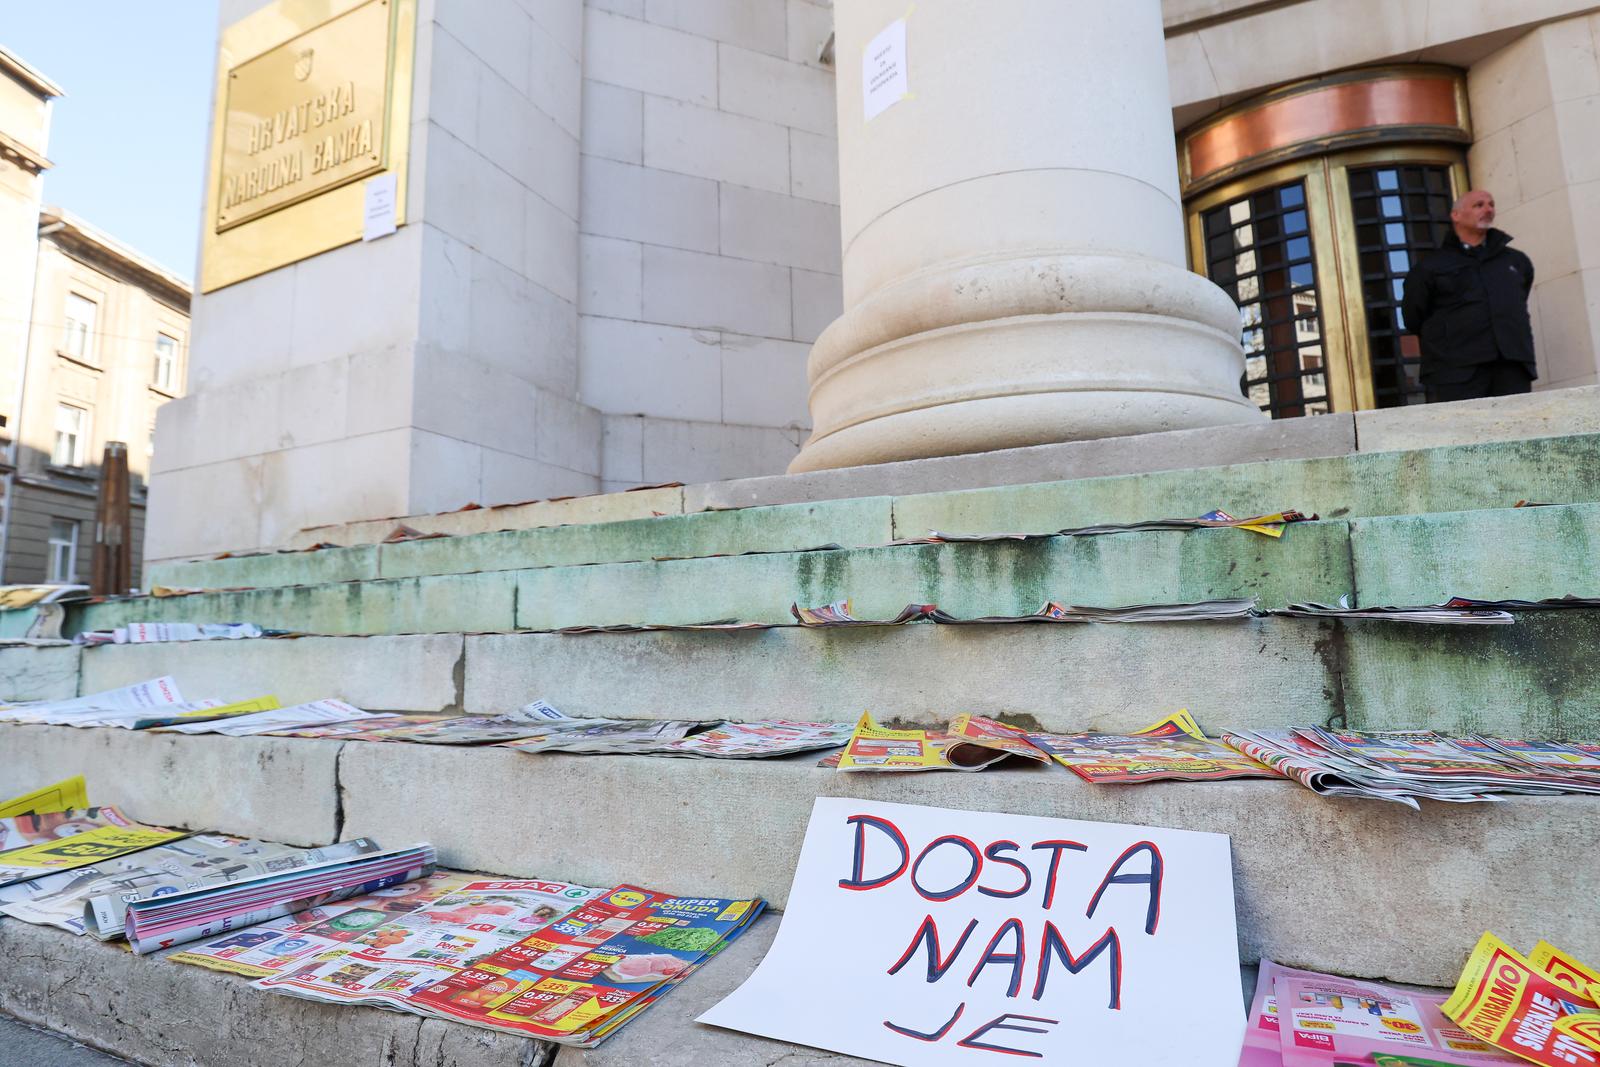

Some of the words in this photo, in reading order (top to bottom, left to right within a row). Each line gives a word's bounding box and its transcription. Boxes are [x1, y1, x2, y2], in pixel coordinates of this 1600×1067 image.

[248, 81, 354, 157] HRVATSKA
[224, 150, 303, 209] NARODNA
[312, 119, 373, 175] BANKA
[485, 881, 561, 893] SPAR
[665, 899, 719, 907] SUPER
[838, 814, 1164, 935] DOSTA
[554, 923, 585, 936] -35%
[650, 902, 720, 914] PONUDA
[887, 914, 1121, 1010] NAM
[883, 1002, 1060, 1058] JE
[1466, 964, 1521, 1040] ZATVARAMO
[1512, 991, 1561, 1052] SNIŽENJE
[1299, 1032, 1330, 1042] BIPA
